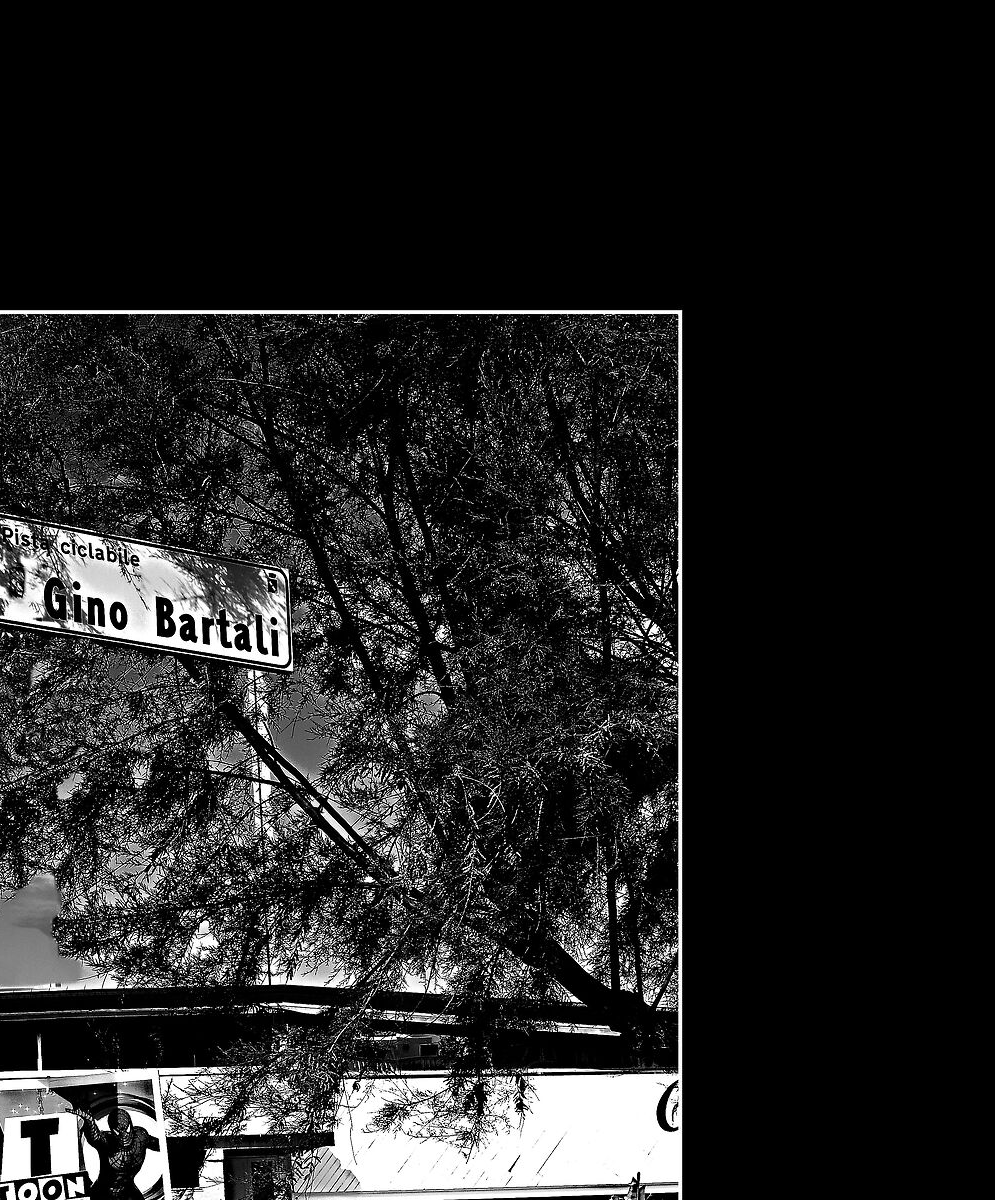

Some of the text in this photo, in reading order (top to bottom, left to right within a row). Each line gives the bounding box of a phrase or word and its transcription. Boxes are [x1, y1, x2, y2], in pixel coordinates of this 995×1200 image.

[4, 526, 140, 567] Pista ciclabile
[43, 576, 279, 657] Gino Bartali
